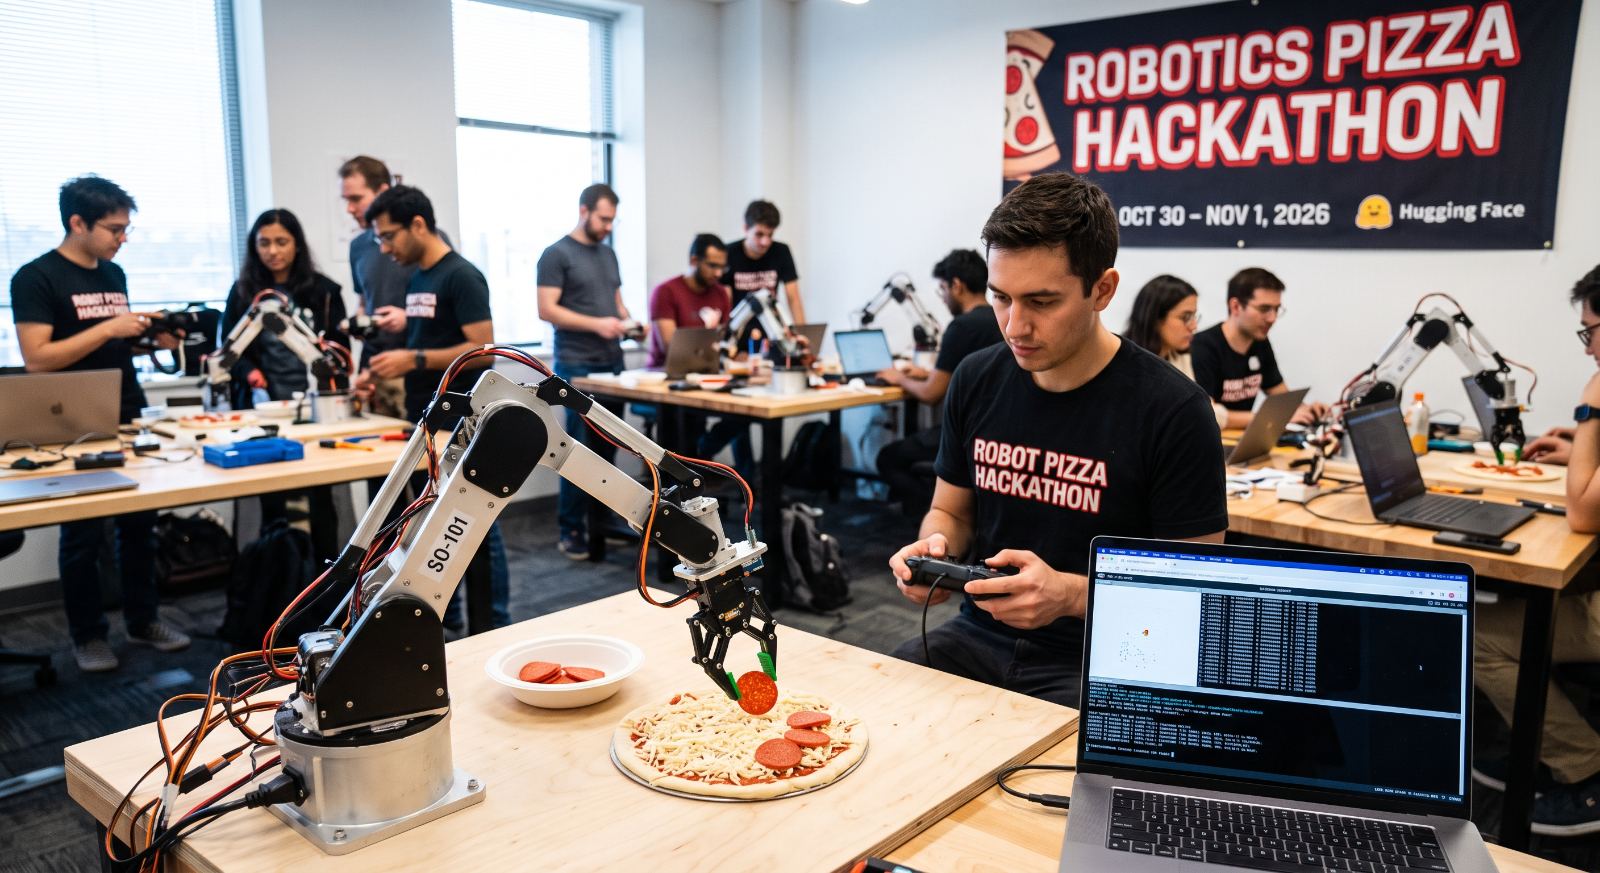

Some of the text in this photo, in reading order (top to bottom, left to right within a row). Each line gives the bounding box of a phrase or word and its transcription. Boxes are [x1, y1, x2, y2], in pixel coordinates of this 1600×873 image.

[1064, 1, 1520, 105] ROBOTICS PIZZA
[1072, 76, 1505, 173] HACKATHON
[1118, 205, 1156, 227] OCT
[1158, 205, 1186, 226] 30
[1205, 204, 1250, 226] NOV
[1252, 203, 1269, 229] 1,
[1272, 202, 1330, 226] 2026
[1399, 201, 1526, 223] Hugging Face
[973, 437, 1109, 488] ROBOT PIZZA
[974, 464, 1102, 514] HACKATHON
[427, 516, 468, 573] SO-101
